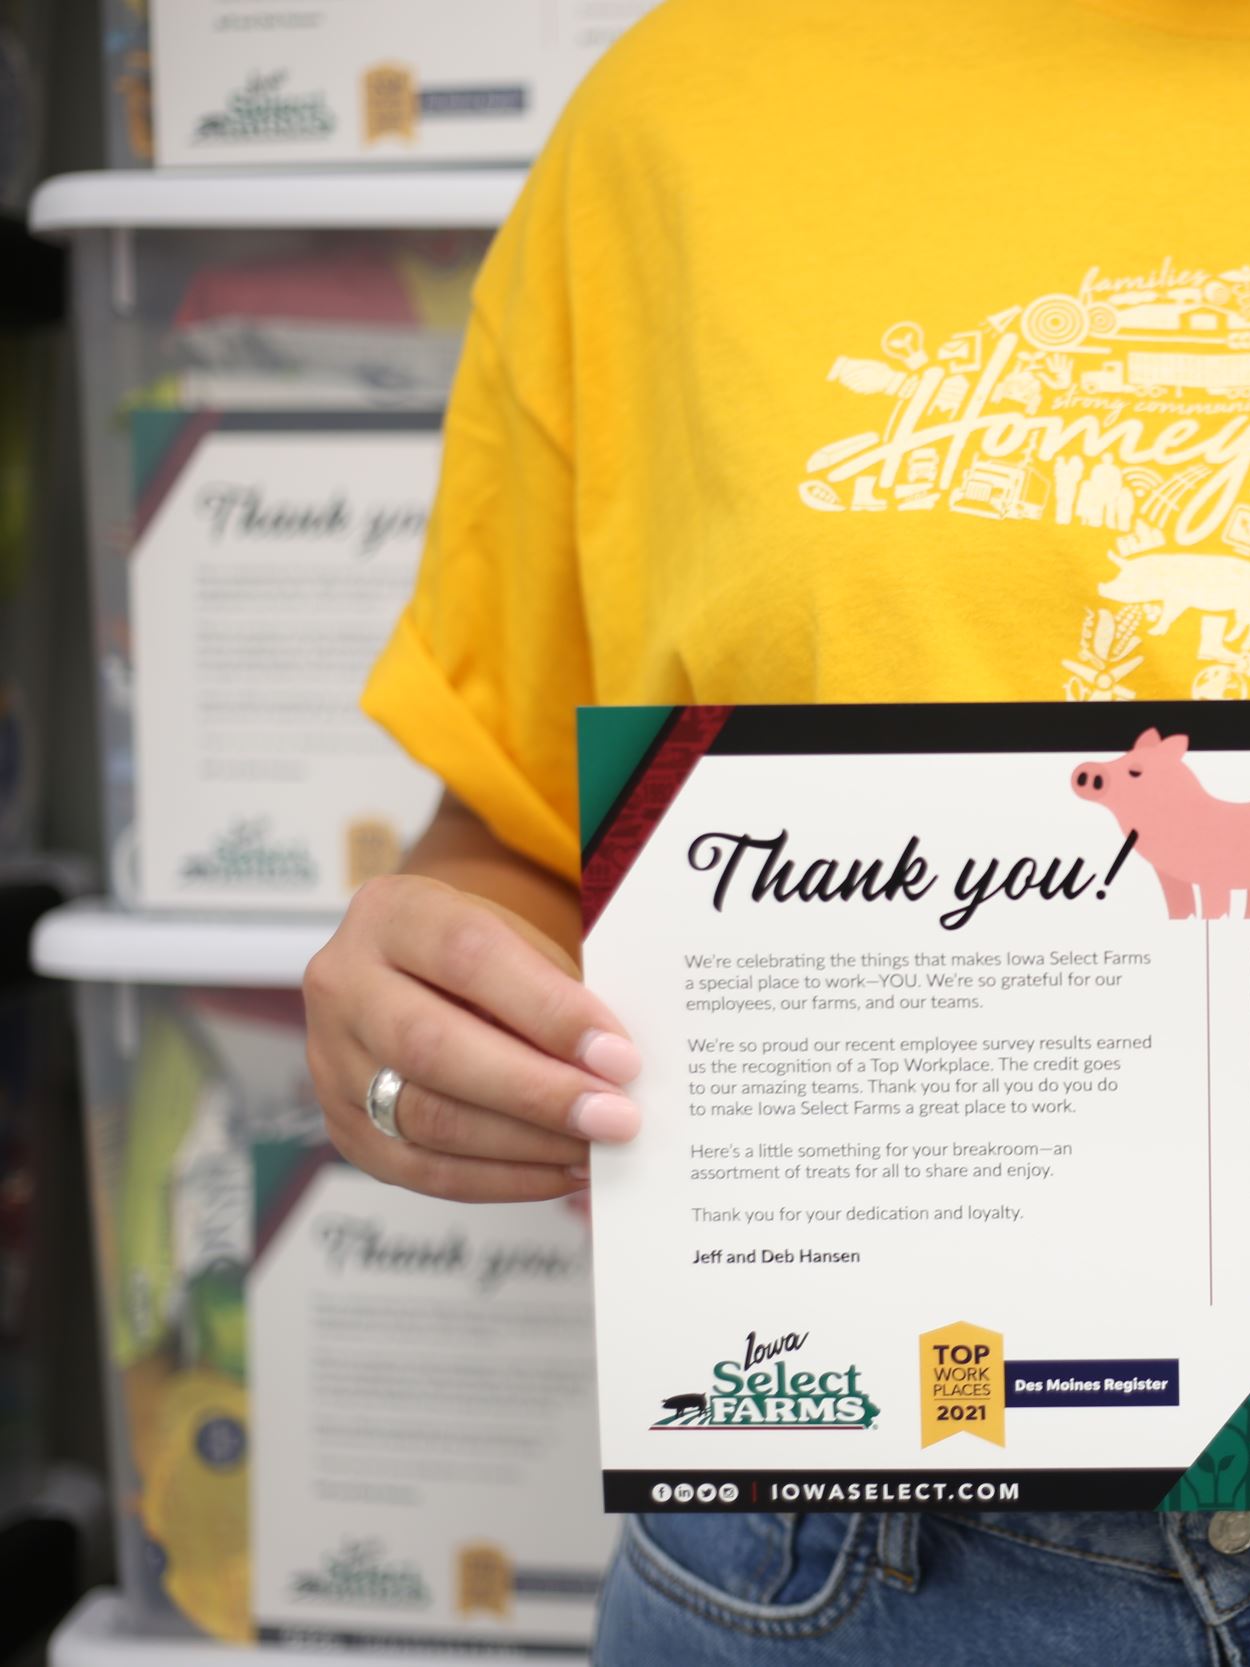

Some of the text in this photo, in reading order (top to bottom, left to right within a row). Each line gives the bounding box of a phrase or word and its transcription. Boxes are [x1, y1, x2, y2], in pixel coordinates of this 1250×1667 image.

[1078, 255, 1213, 304] families
[1050, 383, 1129, 429] strong
[687, 828, 1139, 931] Thank you!
[683, 950, 1152, 973] We're celebrating the things that makes Iowa Select Farms
[684, 972, 1123, 995] a special place to work—YOU. We're so grateful for our
[685, 994, 984, 1016] employees, our farms, and our teams.
[690, 1141, 1073, 1163] Here's a little something for your breakroom—an
[690, 1162, 1054, 1183] assortment of treats for all to share and enjoy.
[691, 1205, 1024, 1227] Thank you for your dedication and loyalty.
[692, 1248, 861, 1265] Jeff and Deb Hansen
[743, 1330, 810, 1372] Iowa
[932, 1344, 991, 1366] TOP
[711, 1360, 864, 1397] Select
[933, 1366, 990, 1382] WORK
[1014, 1376, 1170, 1394] Des Moines Register
[932, 1382, 992, 1398] PLACES
[710, 1396, 868, 1424] FARMS
[935, 1404, 988, 1422] 2021
[770, 1482, 1020, 1502] IOWASELECT.COM
